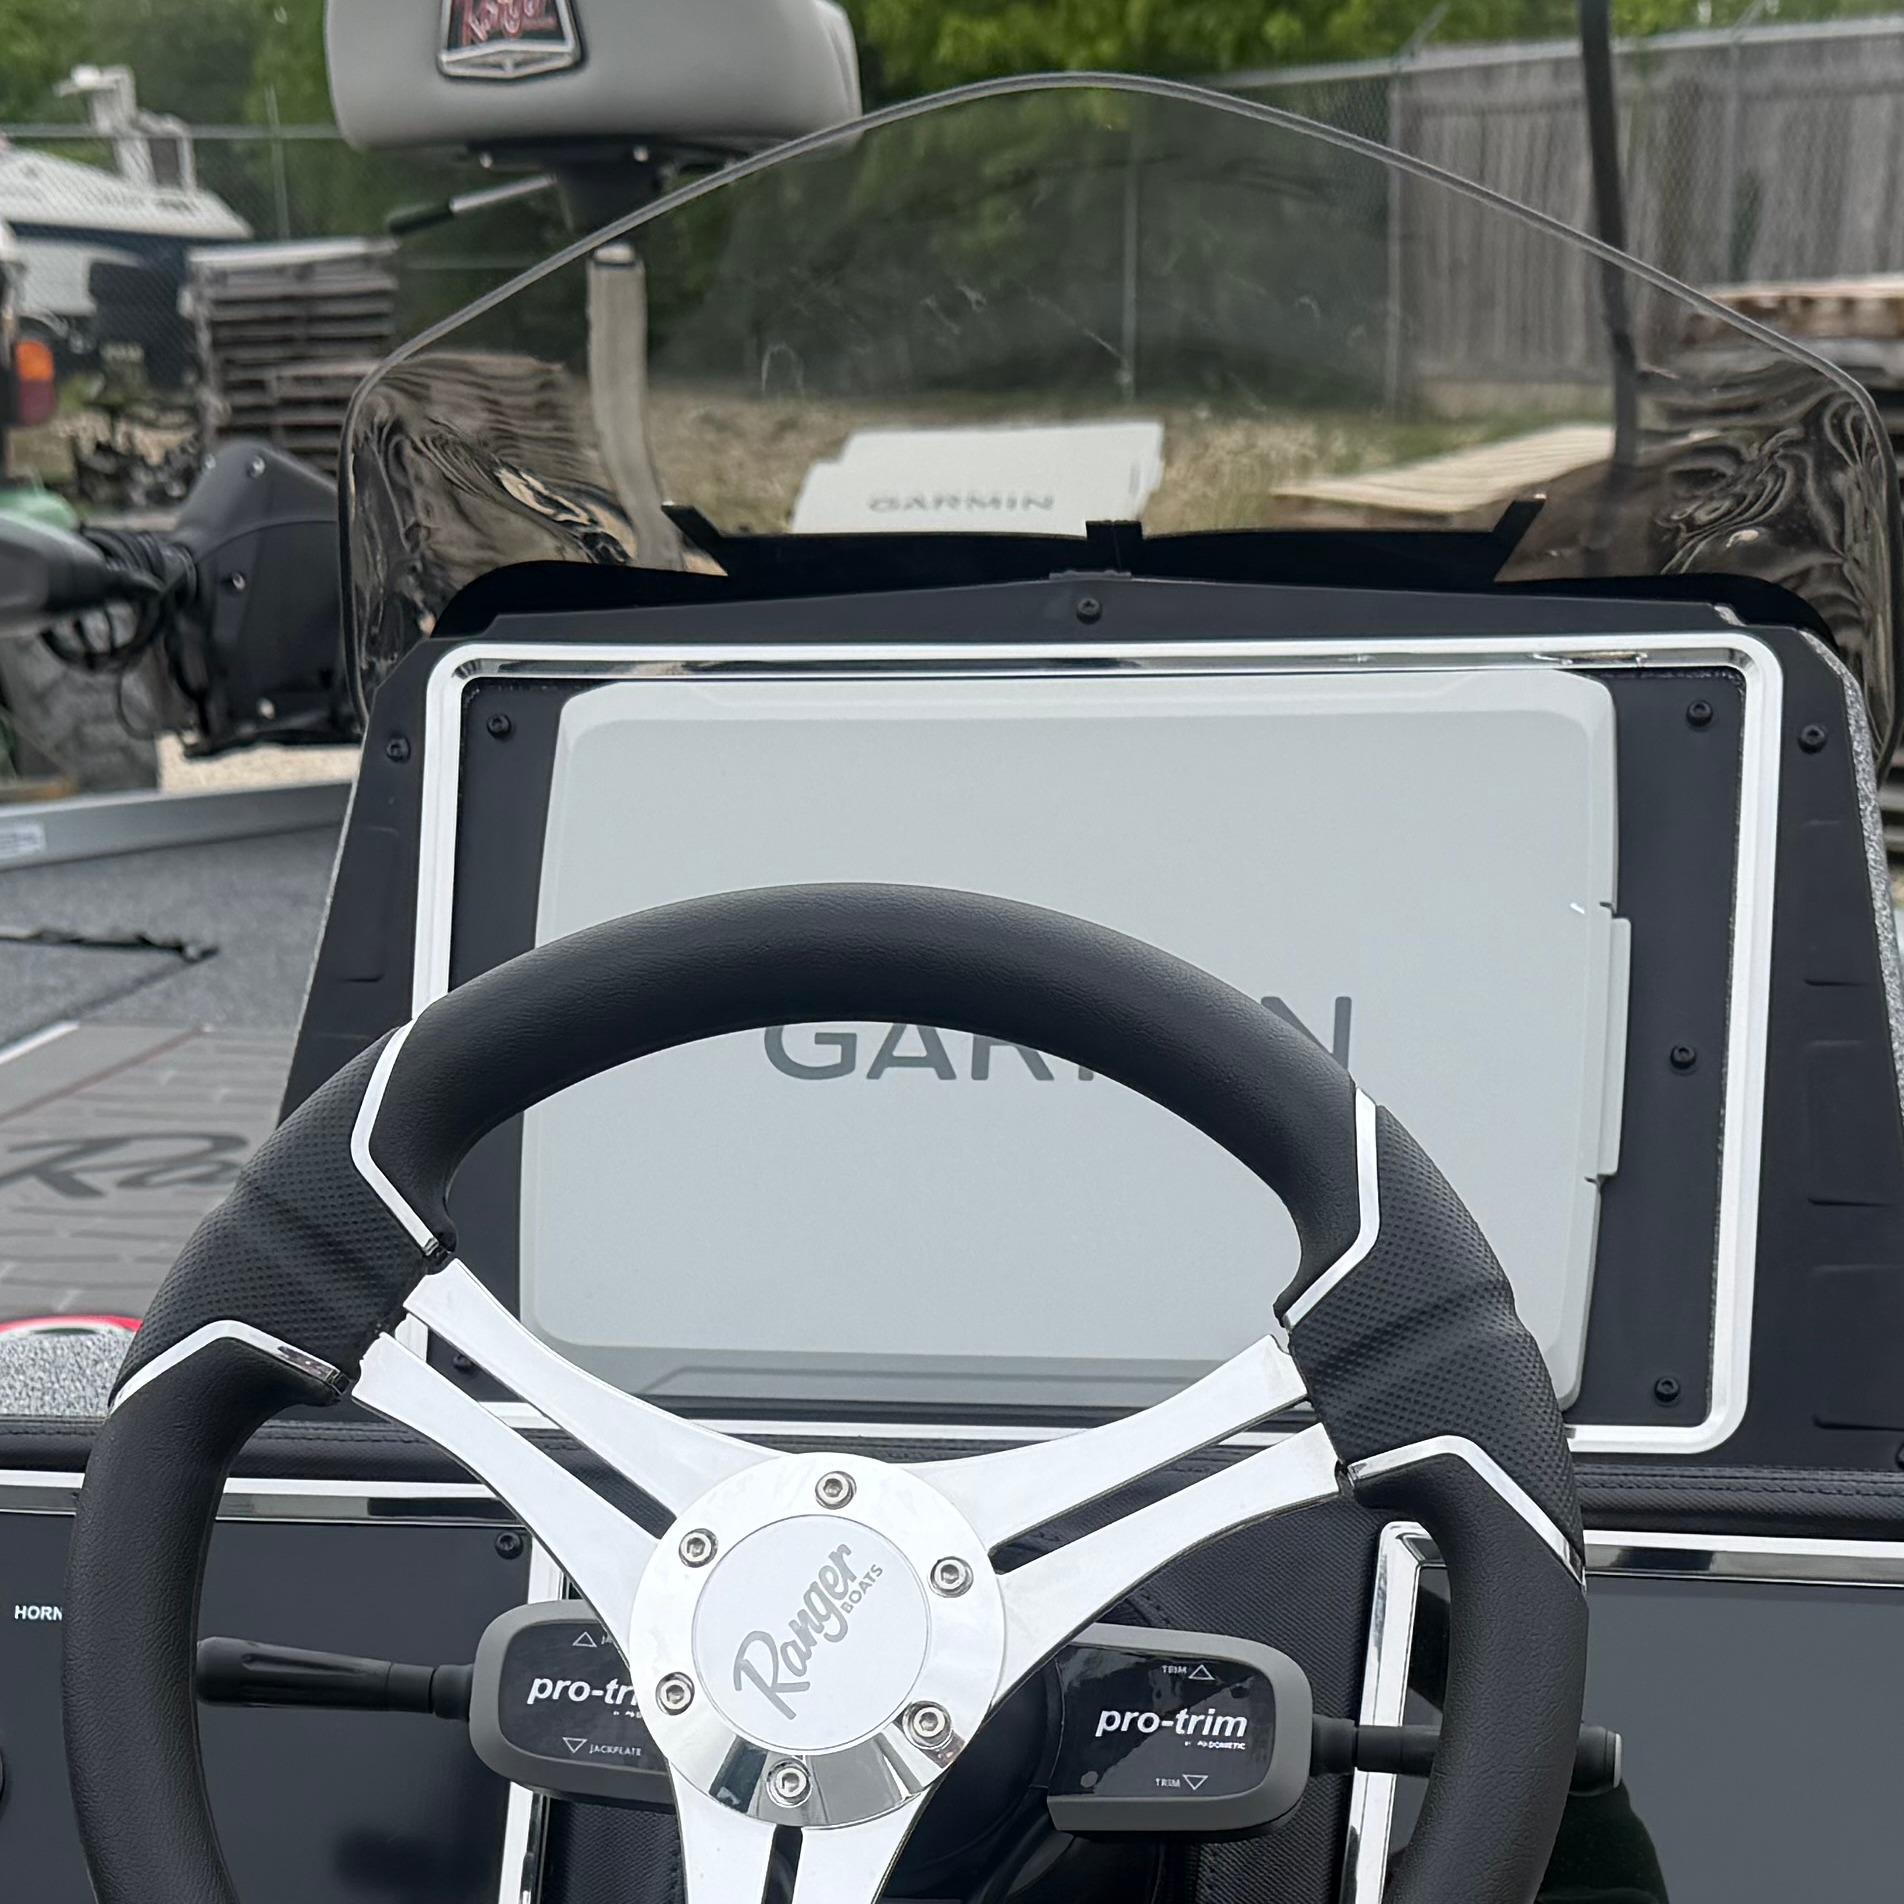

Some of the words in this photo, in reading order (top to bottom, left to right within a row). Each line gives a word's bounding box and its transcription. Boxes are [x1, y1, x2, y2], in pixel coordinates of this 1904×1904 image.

[866, 496, 1055, 513] GARMIN
[763, 996, 1352, 1082] GARN
[840, 1564, 884, 1614] BOATS
[13, 1605, 63, 1621] HORN
[732, 1543, 857, 1720] Ranger
[526, 1677, 639, 1706] pro-tr
[1095, 1708, 1248, 1738] pro-trim
[1155, 1777, 1181, 1788] TRIM
